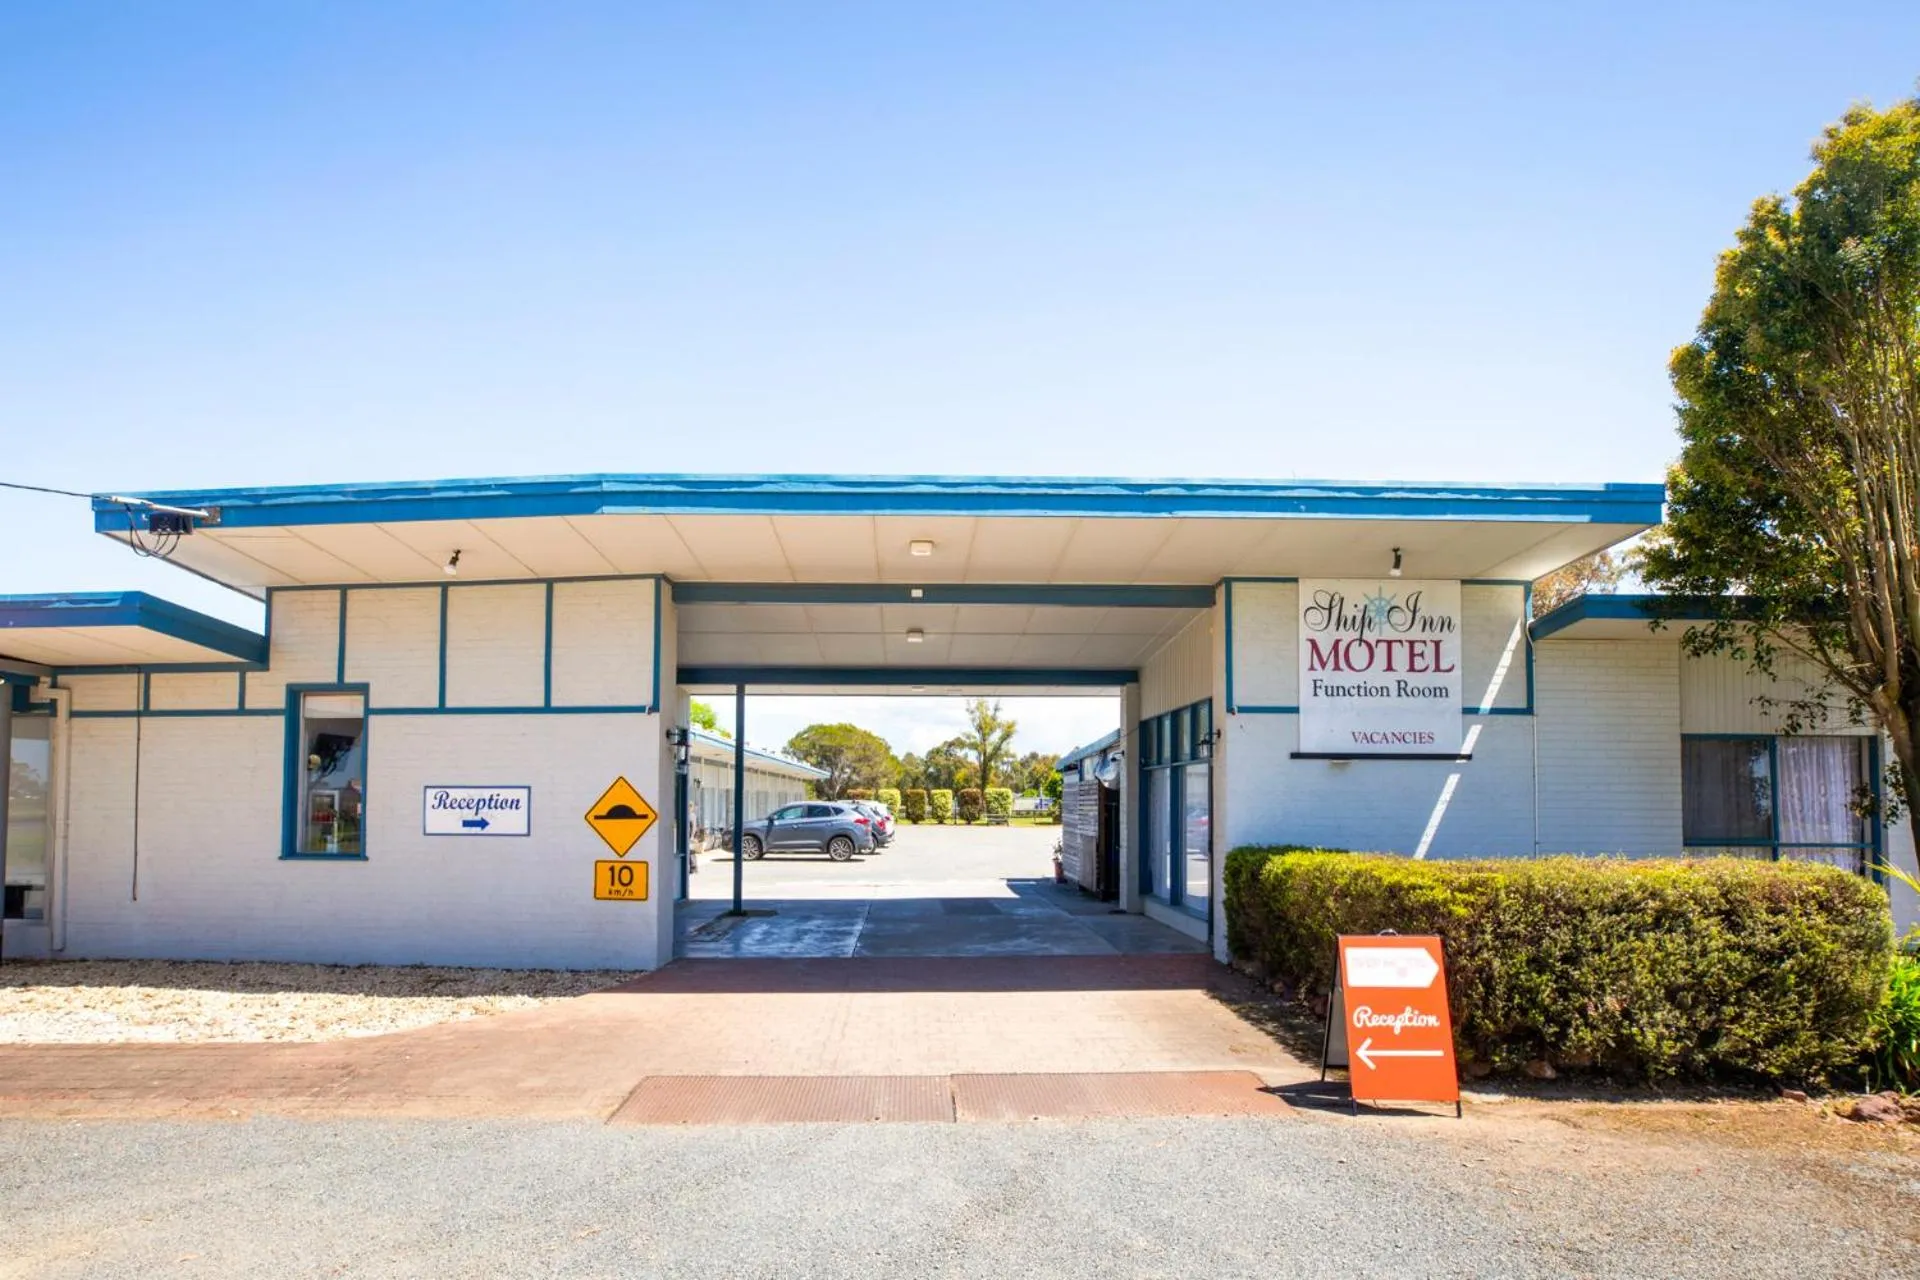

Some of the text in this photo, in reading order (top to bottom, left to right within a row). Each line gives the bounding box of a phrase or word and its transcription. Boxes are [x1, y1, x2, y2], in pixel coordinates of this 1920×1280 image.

[1304, 589, 1455, 647] Ship Inn
[1306, 638, 1455, 672] MOTEL
[1312, 679, 1449, 698] Function Room
[1352, 732, 1435, 744] VACANCIES
[432, 790, 521, 815] Reception
[608, 865, 634, 887] 10
[608, 888, 634, 897] km/h
[1353, 1005, 1440, 1035] Reception
